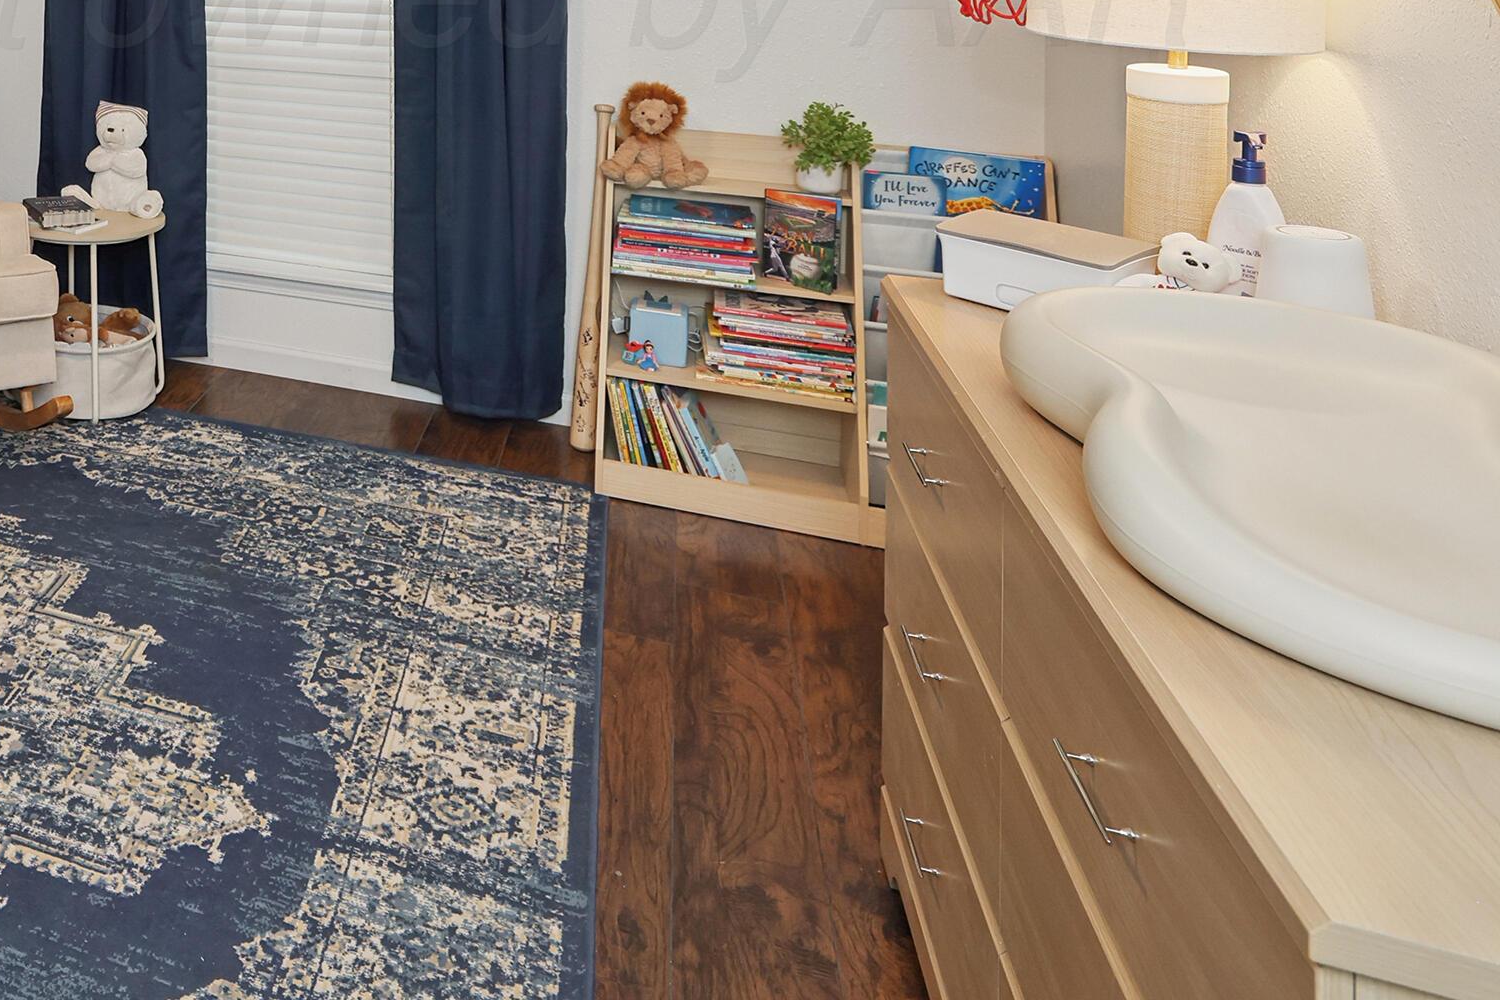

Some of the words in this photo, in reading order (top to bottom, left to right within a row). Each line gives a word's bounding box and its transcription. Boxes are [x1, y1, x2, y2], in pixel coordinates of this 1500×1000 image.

[982, 164, 1021, 180] CAN'T
[906, 181, 929, 195] Love
[944, 177, 997, 194] DANCE
[874, 194, 896, 207] You
[898, 194, 937, 208] Forever
